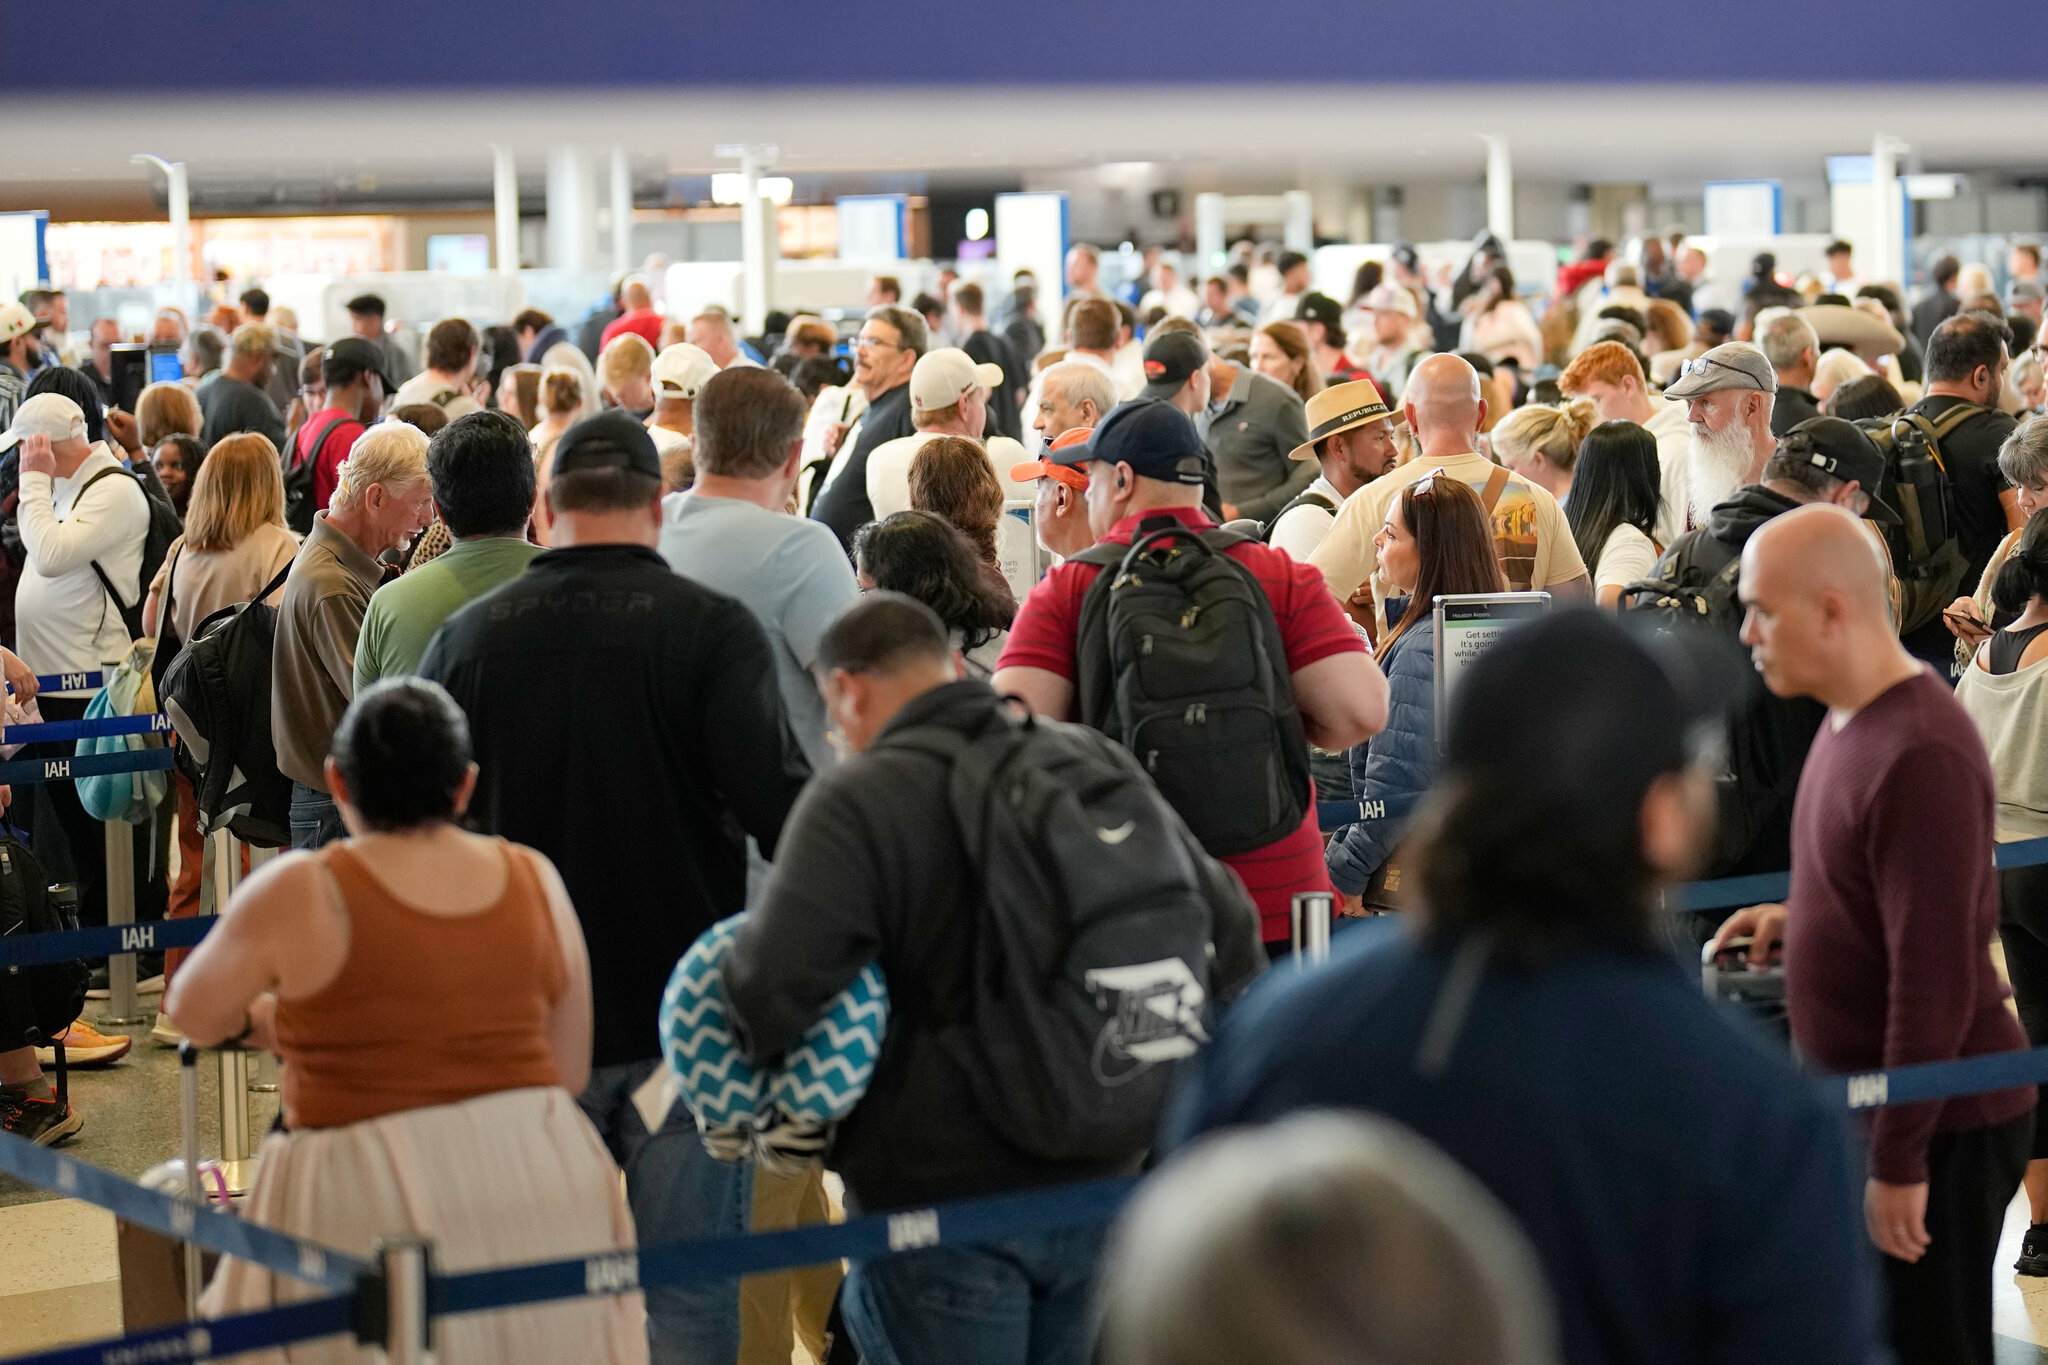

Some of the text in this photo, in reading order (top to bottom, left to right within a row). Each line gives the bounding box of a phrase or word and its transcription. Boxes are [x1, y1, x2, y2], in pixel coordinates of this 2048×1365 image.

[489, 591, 654, 621] SPYDER
[45, 760, 70, 778] IAH
[1359, 800, 1385, 820] IAH
[122, 926, 154, 950] IAH
[1848, 1073, 1888, 1108] IAH
[888, 1209, 939, 1251] IAH
